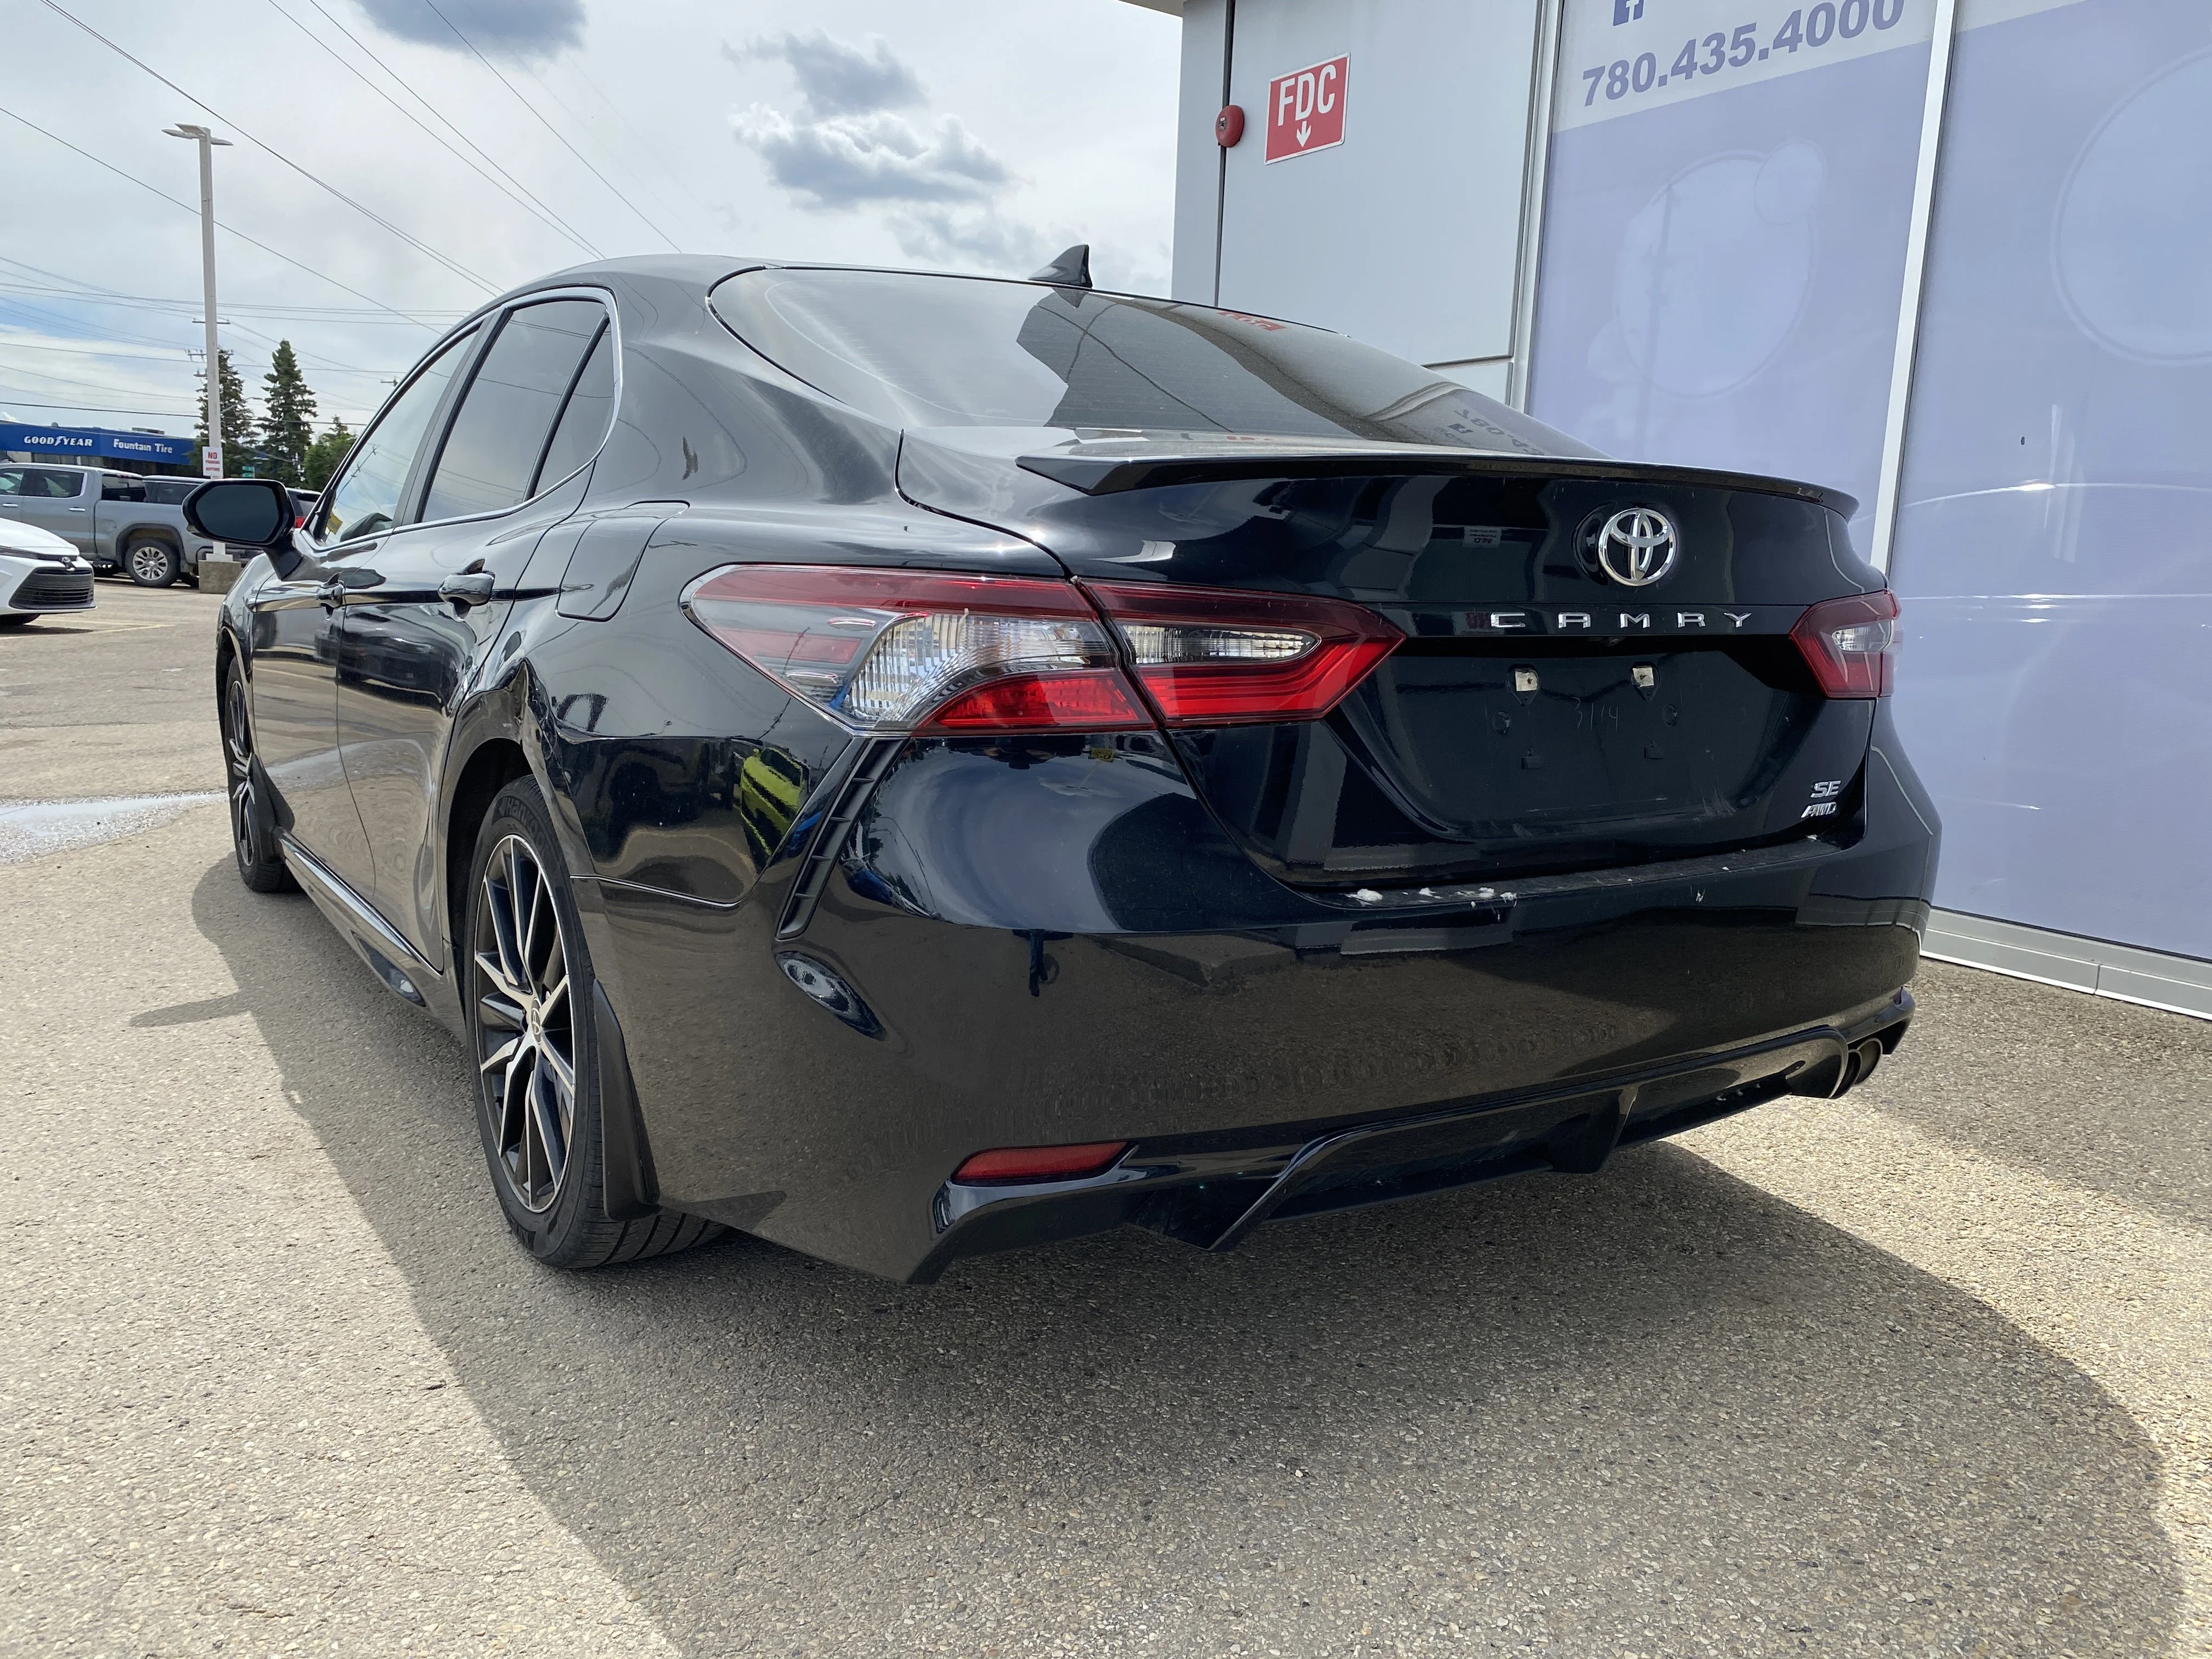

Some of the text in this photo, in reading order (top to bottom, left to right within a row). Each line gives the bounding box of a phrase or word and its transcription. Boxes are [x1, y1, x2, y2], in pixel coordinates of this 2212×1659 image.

[1582, 0, 1905, 107] 780.435.4000
[1277, 64, 1336, 126] FDC
[24, 436, 93, 447] GOODYEAR
[113, 438, 173, 454] Fountain Tire
[1491, 612, 1752, 628] CAMRY
[1810, 780, 1841, 798] SE
[1801, 802, 1837, 818] AWD
